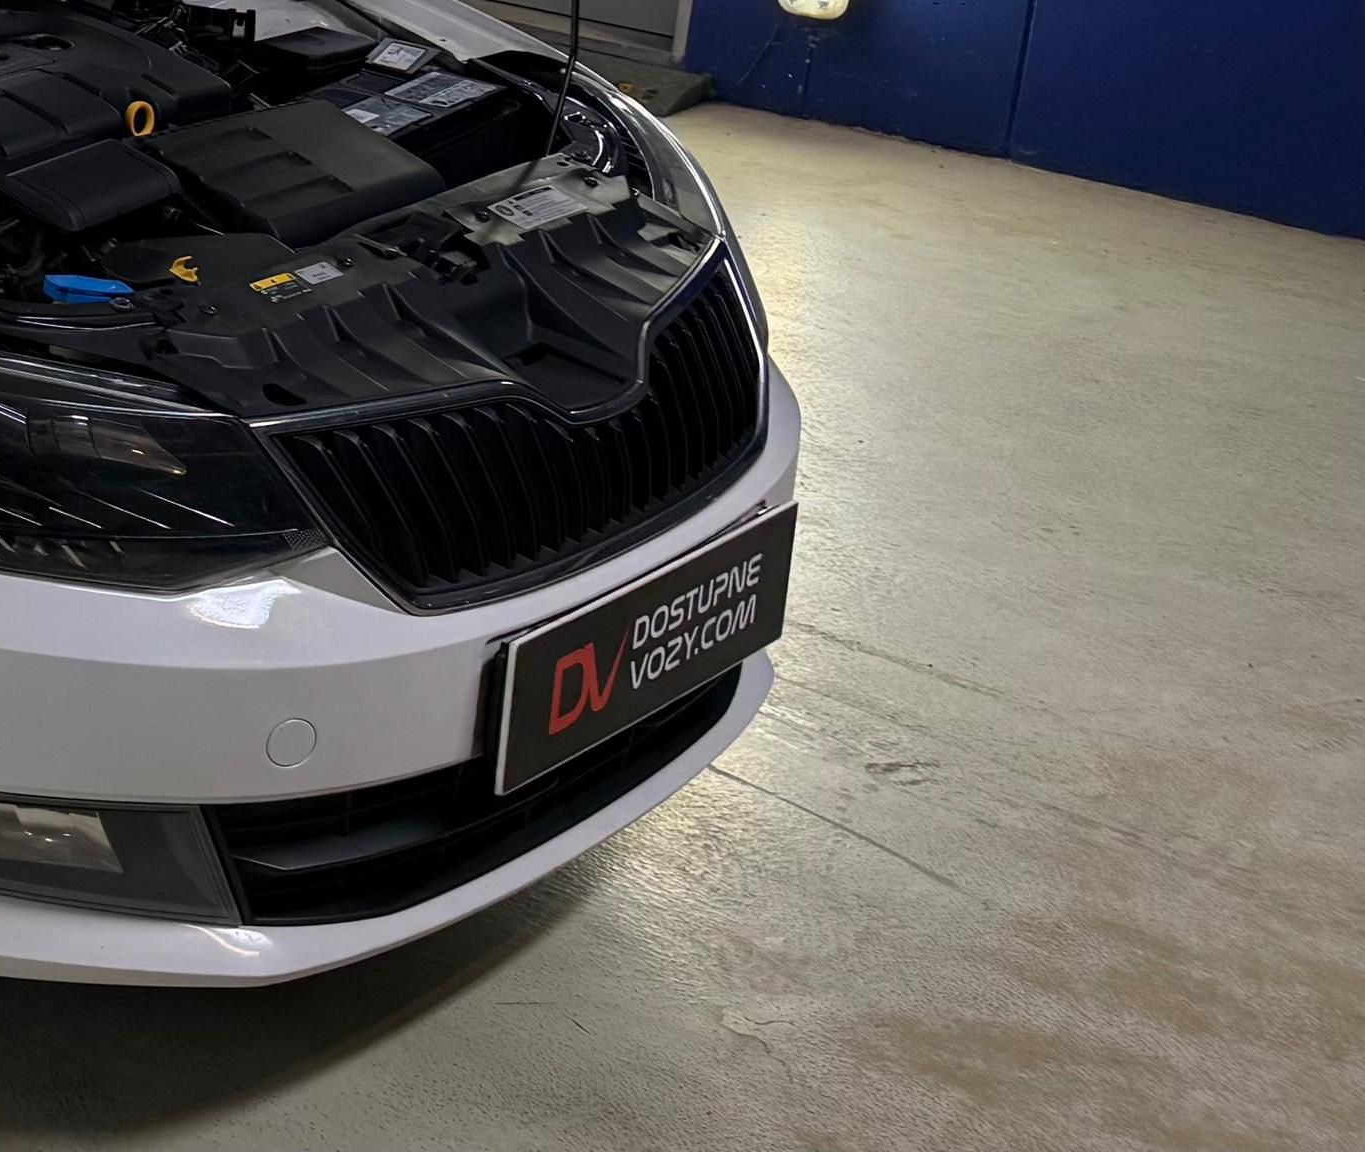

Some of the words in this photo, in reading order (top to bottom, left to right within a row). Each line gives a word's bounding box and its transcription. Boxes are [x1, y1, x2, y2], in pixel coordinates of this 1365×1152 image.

[630, 593, 757, 690] VOZY.COM
[632, 552, 764, 651] DOSTUPNE
[549, 625, 631, 736] DV
